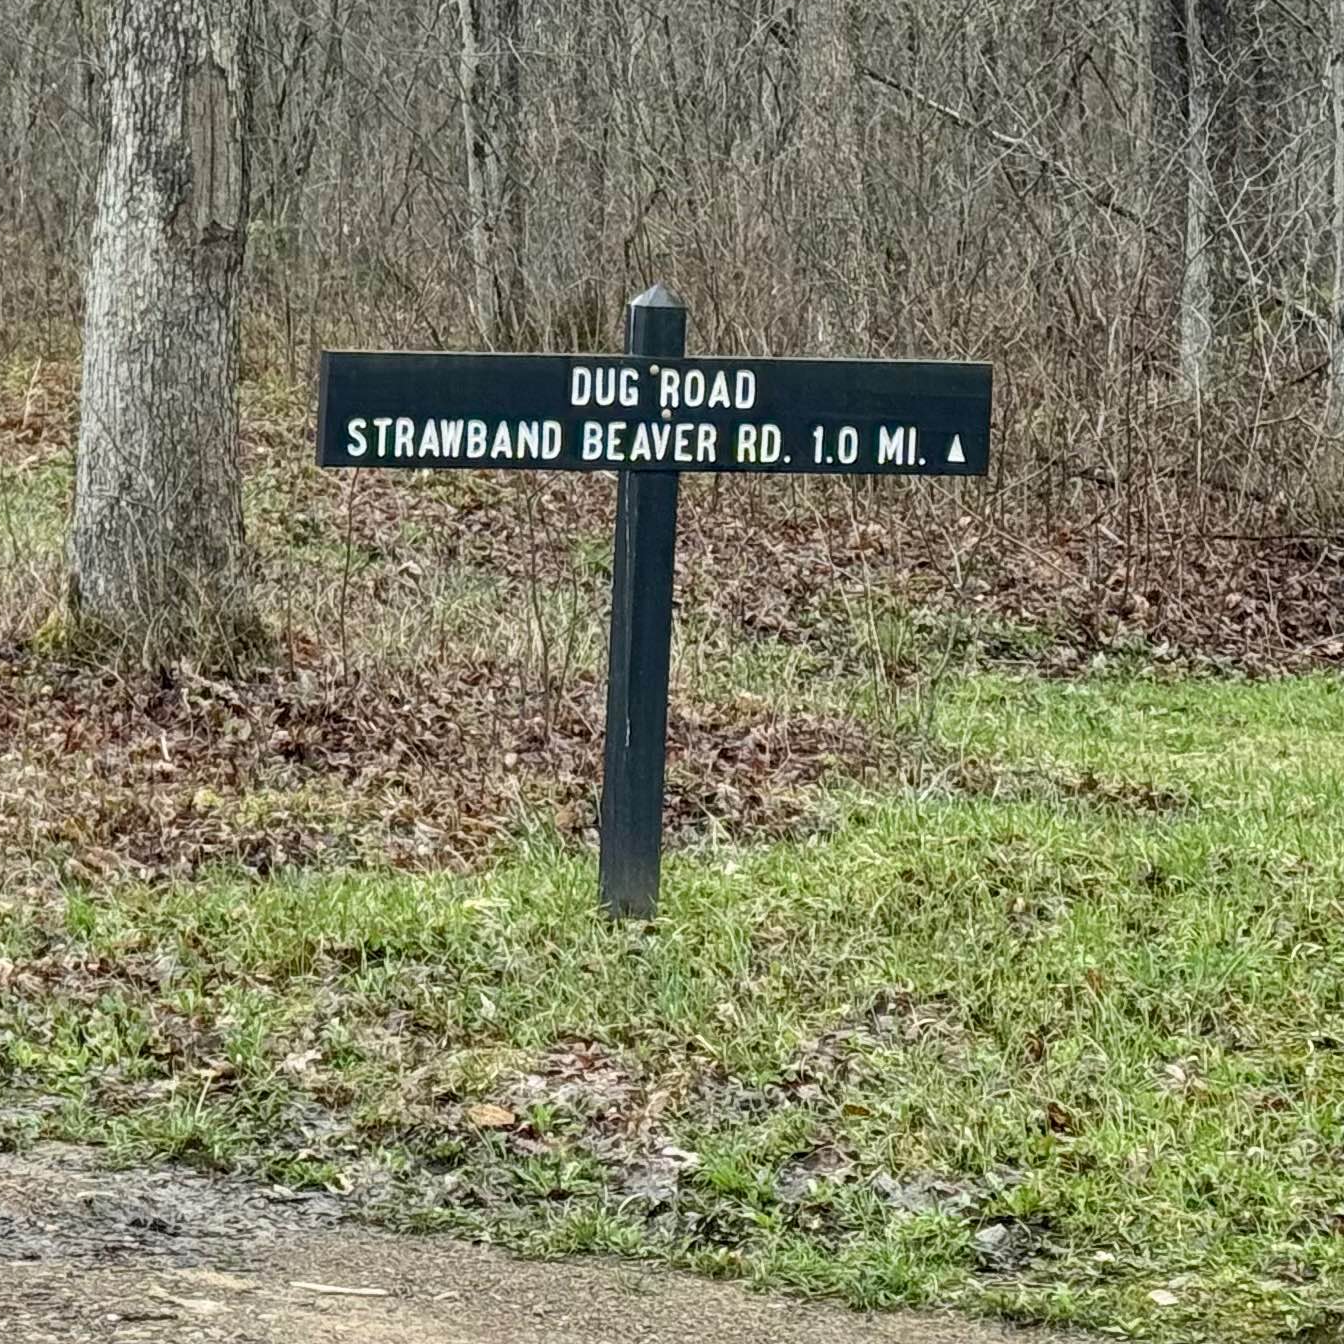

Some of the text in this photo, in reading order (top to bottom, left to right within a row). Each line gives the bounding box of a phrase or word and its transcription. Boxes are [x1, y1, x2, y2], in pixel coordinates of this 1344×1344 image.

[571, 366, 757, 409] DUG ROAD
[346, 417, 927, 466] STRAWBAND BEAVER RD. 1.0 MI.
